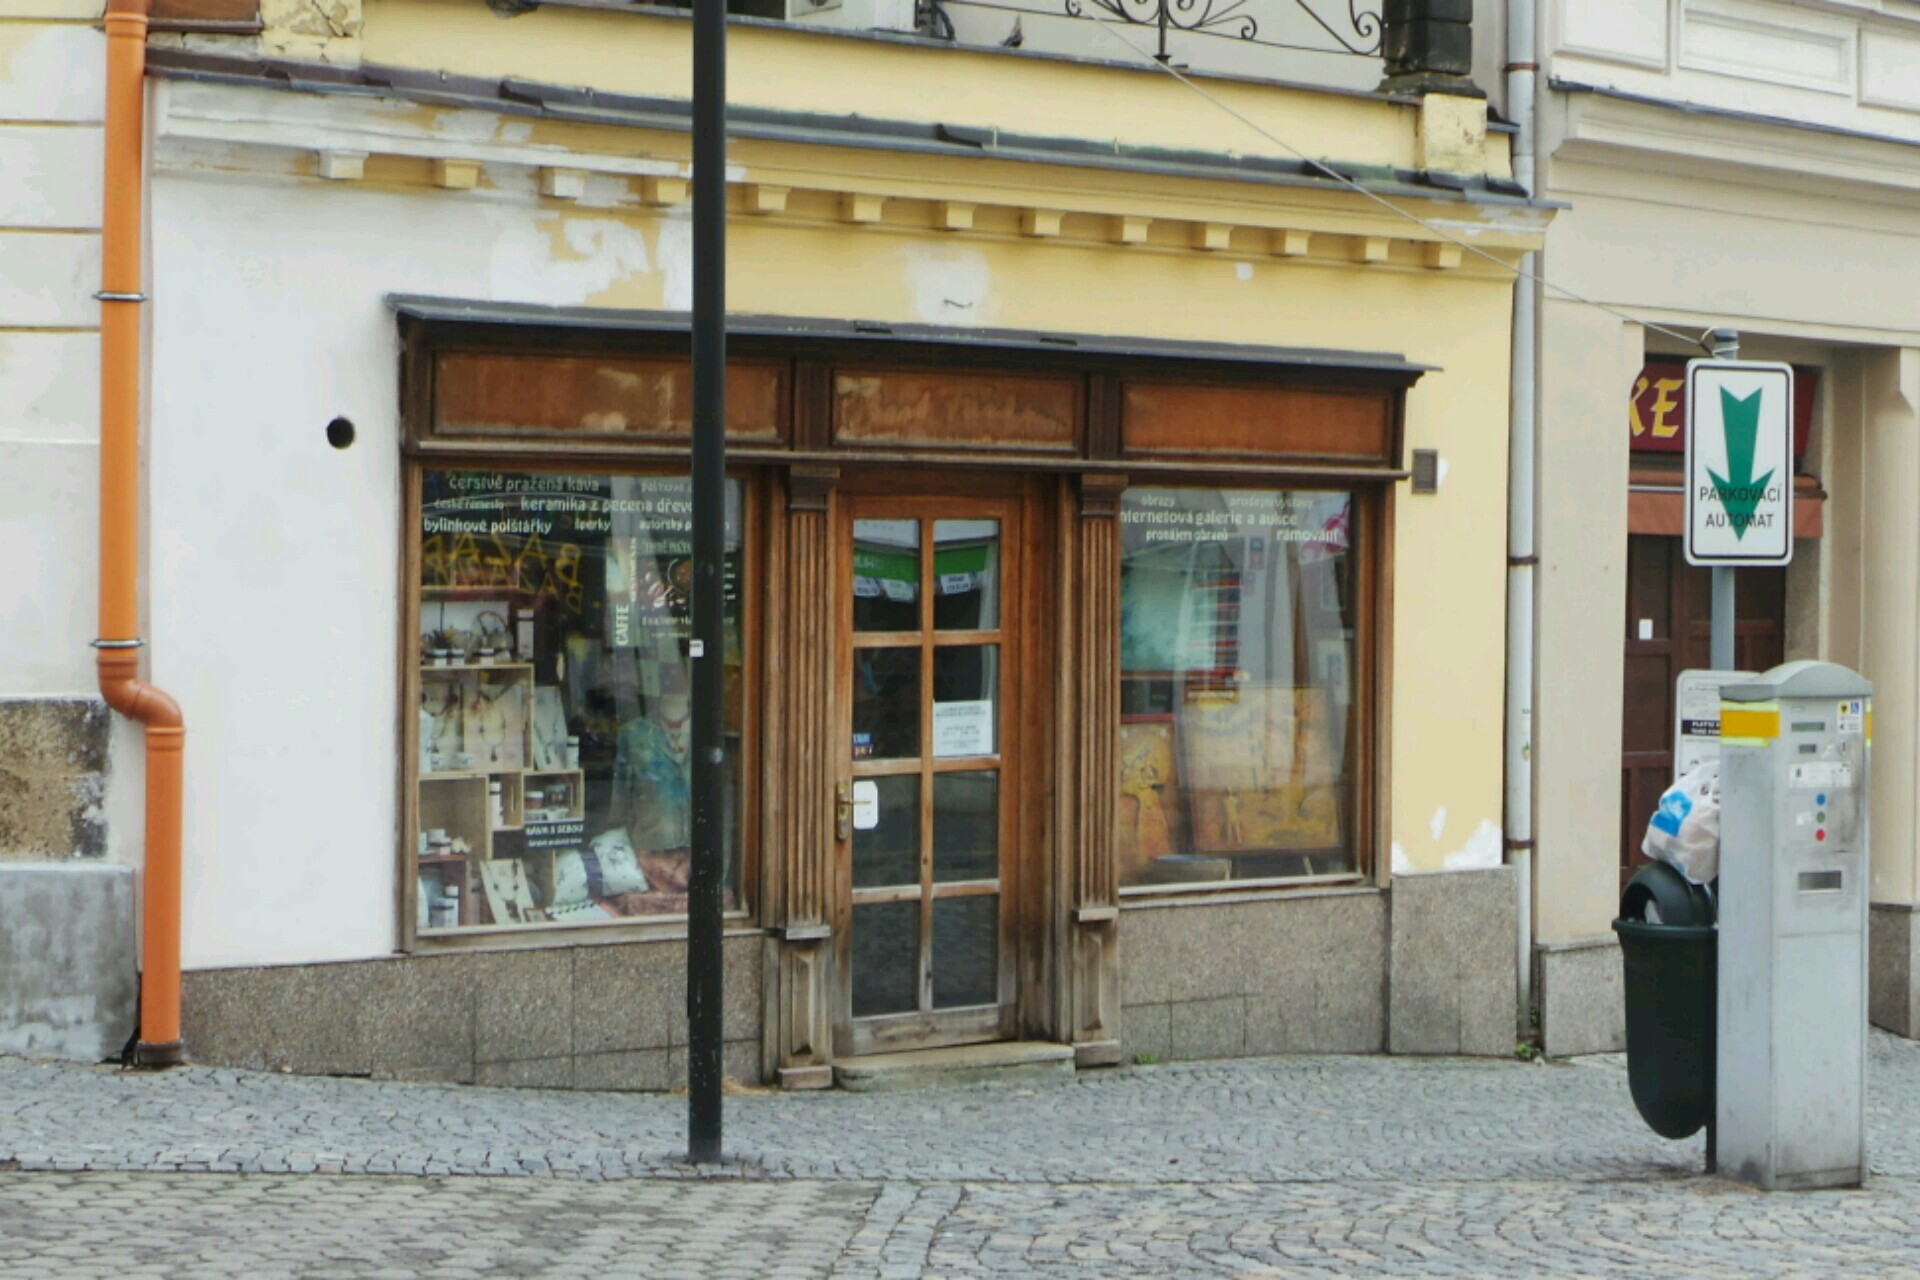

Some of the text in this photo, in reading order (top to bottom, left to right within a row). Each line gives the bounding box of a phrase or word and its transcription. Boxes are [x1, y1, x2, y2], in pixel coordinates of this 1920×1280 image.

[1700, 482, 1781, 502] PARKOVACÍ
[521, 496, 587, 512] keramika
[423, 518, 488, 533] bylinkové
[1120, 509, 1298, 527] nternetová galerie a aukce
[1706, 513, 1774, 528] AUTOMAT
